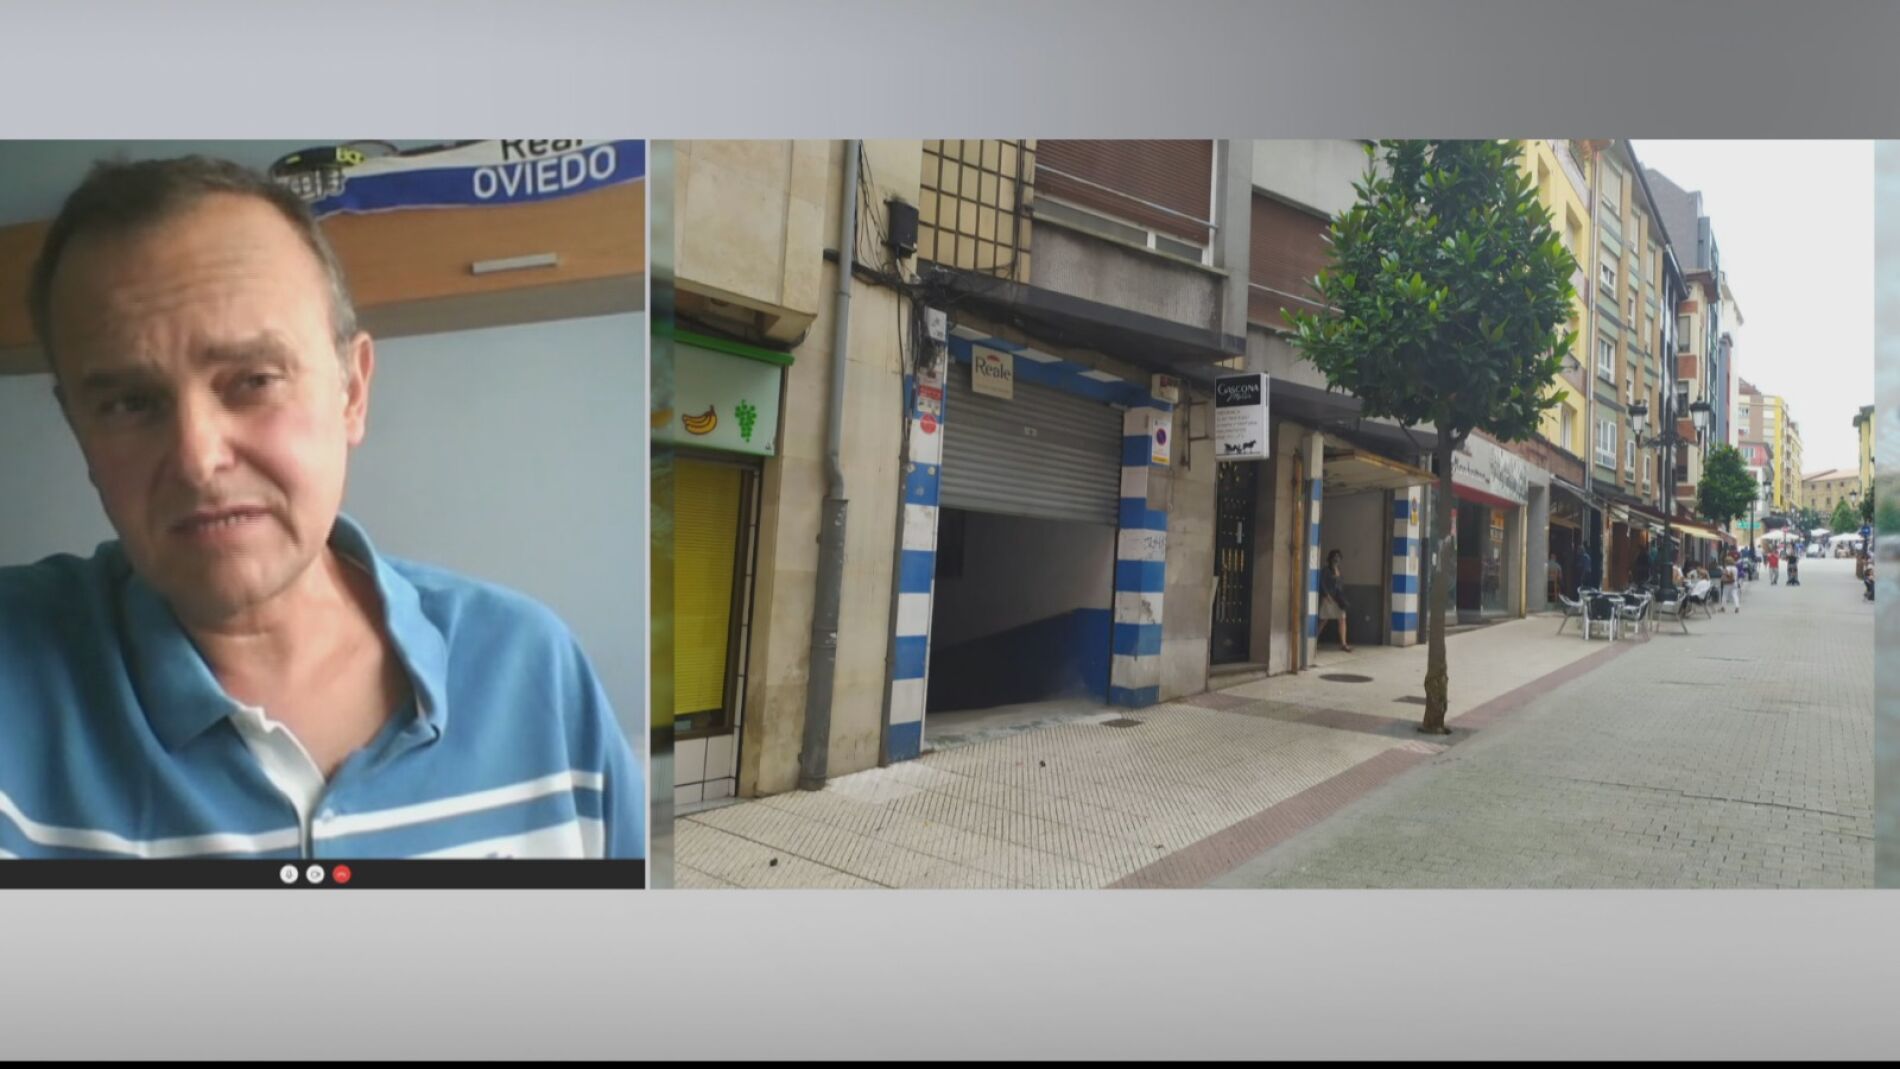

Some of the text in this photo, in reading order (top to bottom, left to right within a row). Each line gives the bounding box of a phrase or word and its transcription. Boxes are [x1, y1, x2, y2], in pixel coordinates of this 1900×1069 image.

[501, 139, 582, 160] Rea
[473, 145, 616, 199] OVIEDO
[975, 356, 1012, 380] Reale
